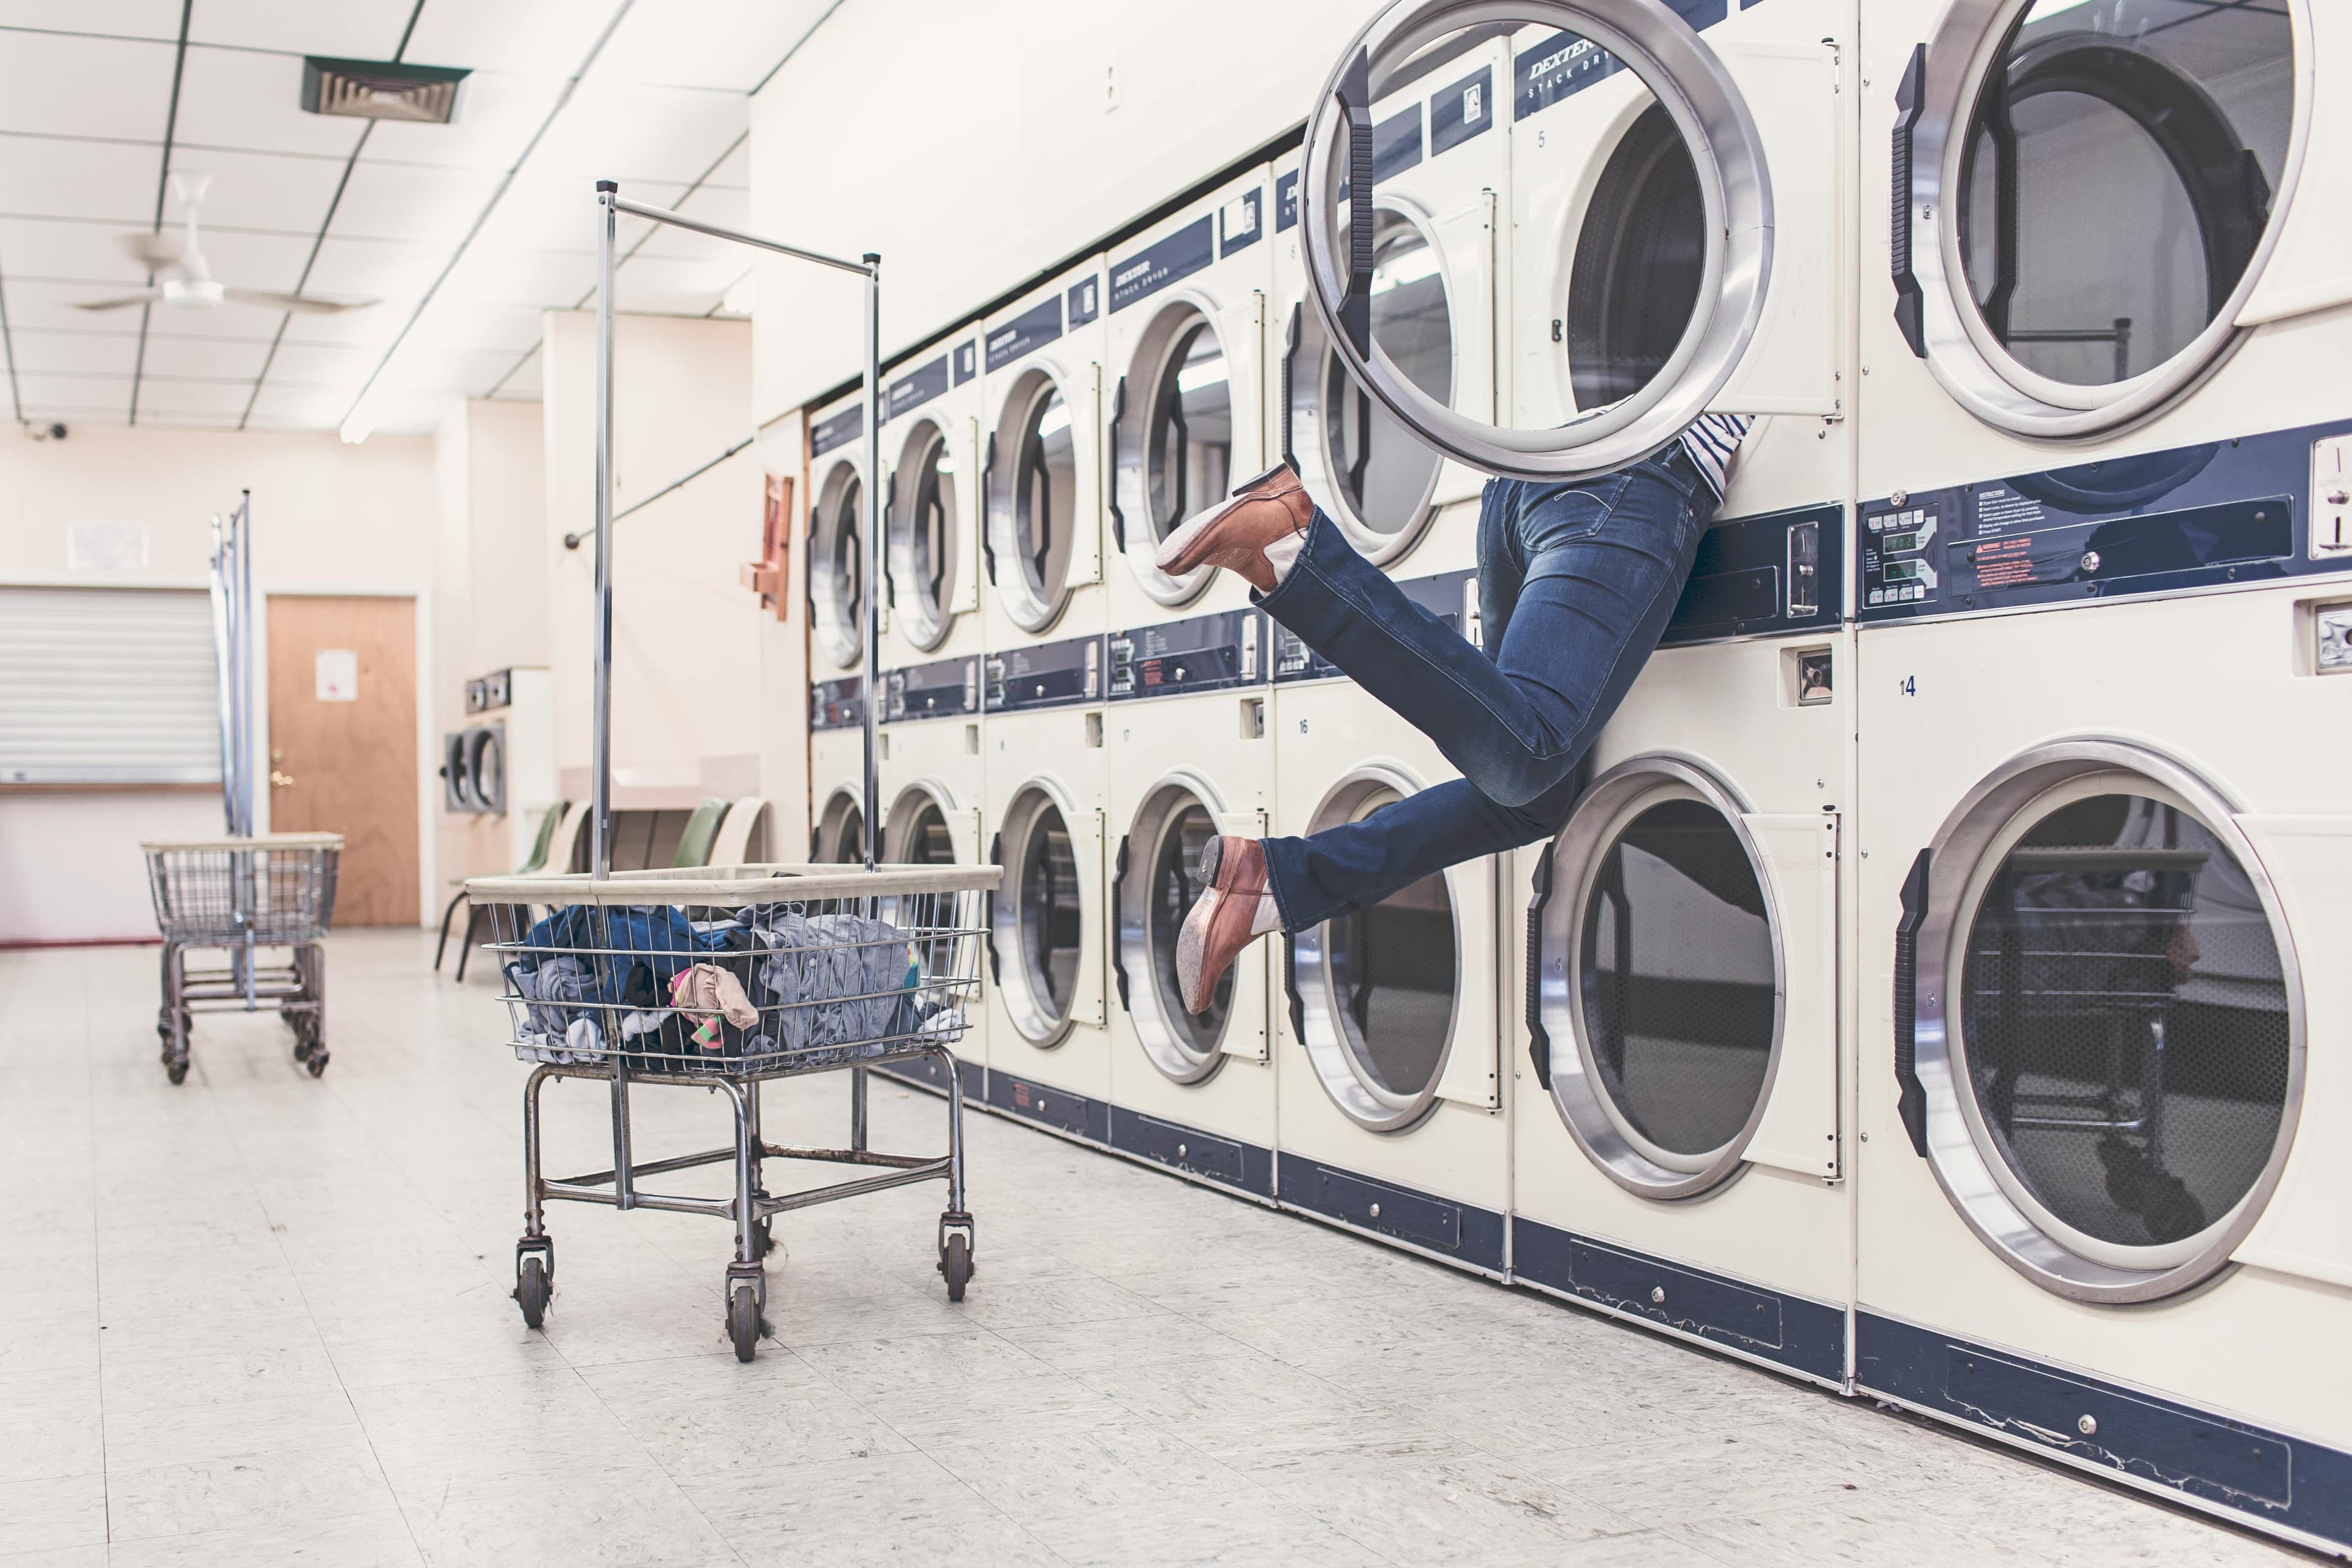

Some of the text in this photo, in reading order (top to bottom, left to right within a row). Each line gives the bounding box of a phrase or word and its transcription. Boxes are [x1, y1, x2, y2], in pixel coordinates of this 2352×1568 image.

[1529, 39, 1594, 80] DEXTER
[1528, 50, 1609, 98] STACK DRY
[1539, 130, 1545, 148] 5
[1900, 676, 1916, 696] 14
[1300, 719, 1308, 734] 16
